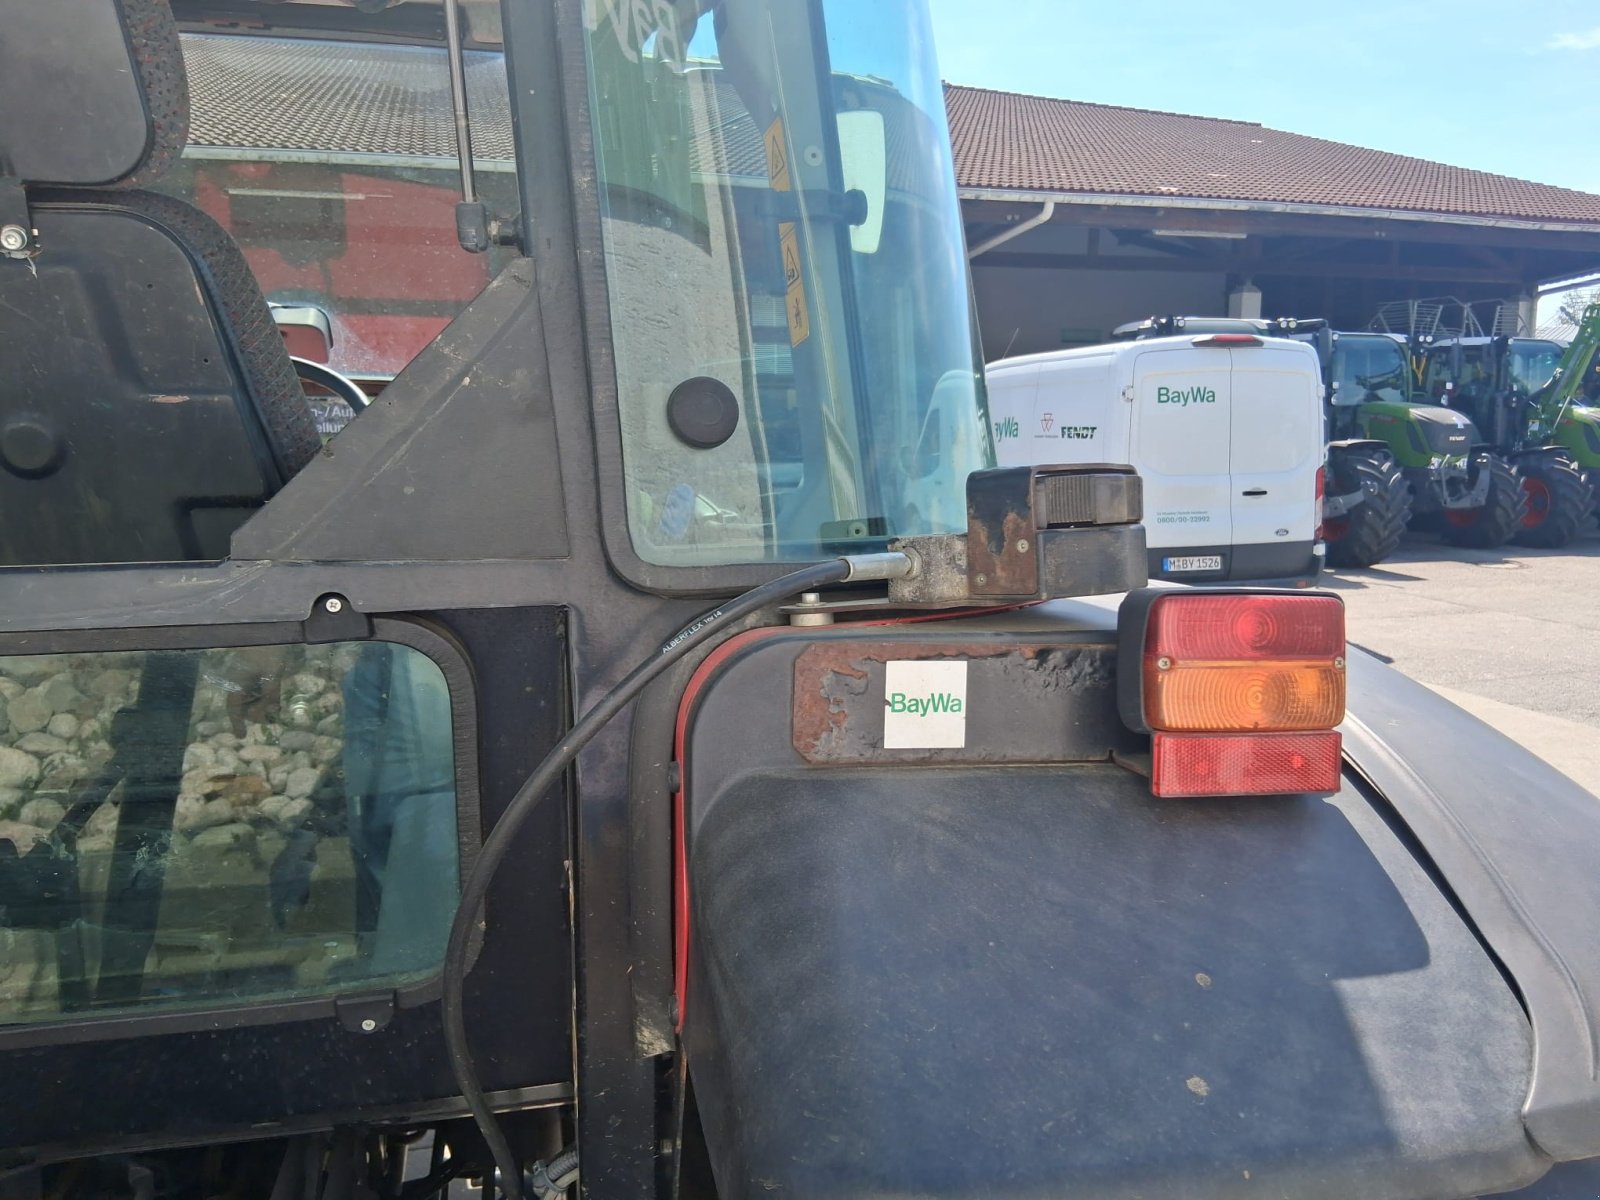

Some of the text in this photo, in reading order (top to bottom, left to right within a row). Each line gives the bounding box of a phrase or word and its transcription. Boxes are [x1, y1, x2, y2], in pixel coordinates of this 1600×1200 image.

[1156, 386, 1217, 407] BayWa
[994, 416, 1019, 442] ayWa
[1061, 426, 1097, 439] FENDT
[1169, 558, 1220, 569] M BY 1526
[662, 621, 704, 654] ALBERFLEX
[890, 692, 962, 717] BayWa
